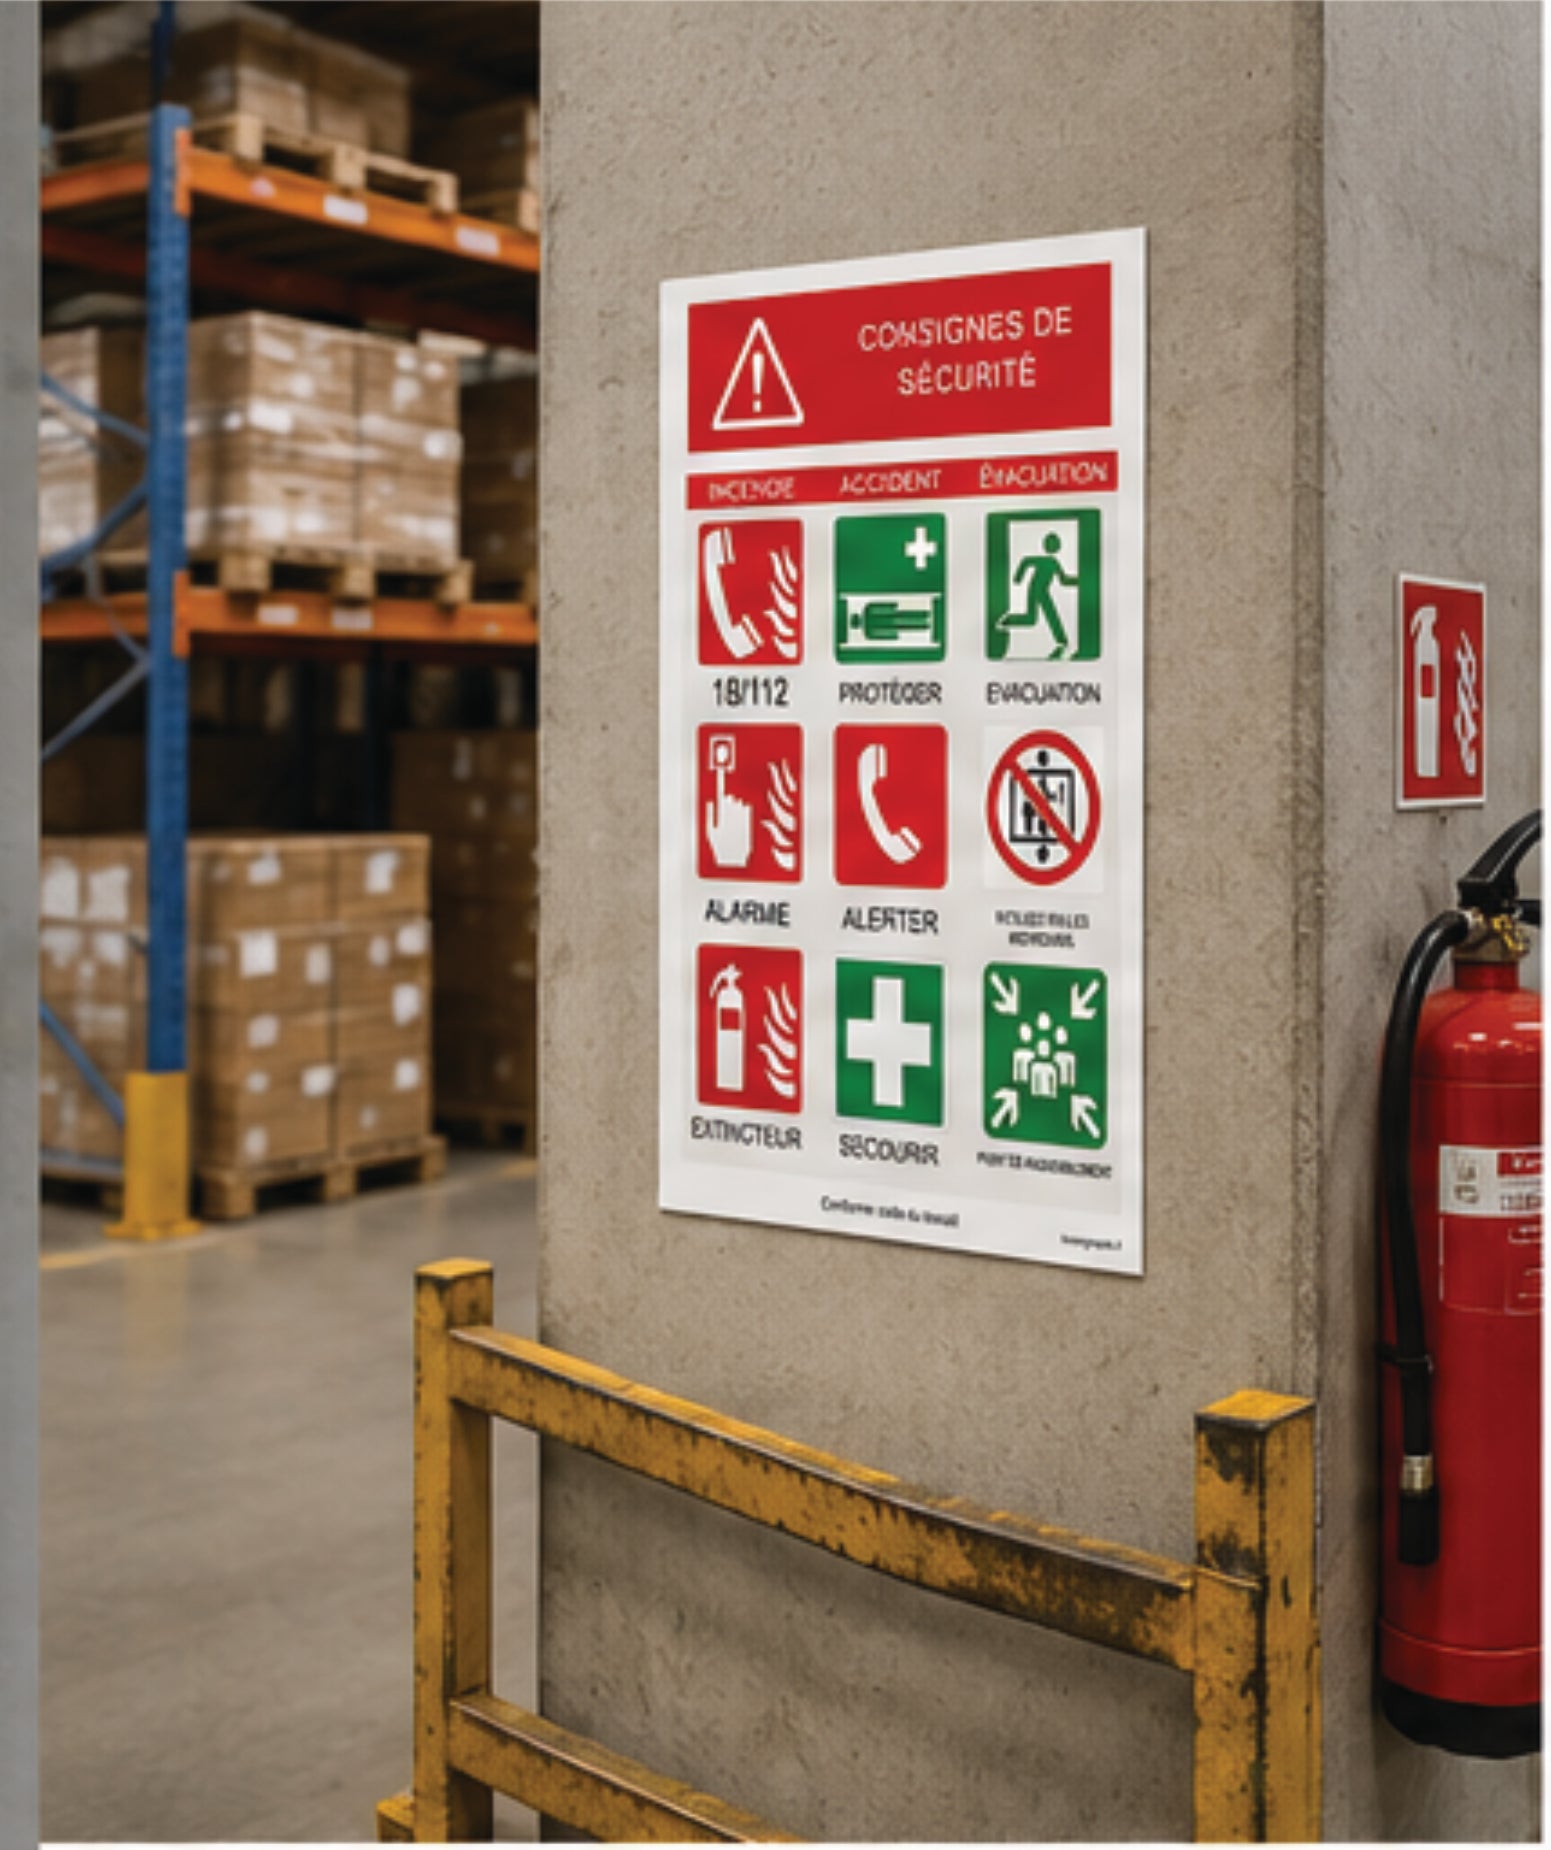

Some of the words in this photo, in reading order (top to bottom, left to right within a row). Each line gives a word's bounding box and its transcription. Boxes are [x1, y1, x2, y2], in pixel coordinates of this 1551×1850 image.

[857, 310, 1024, 351] CONSIGNES
[1033, 306, 1073, 338] DE
[897, 351, 1037, 395] SÉCURITÉ
[839, 470, 942, 495] ACCIDENT
[713, 677, 790, 707] 18/112
[704, 900, 791, 927] ALARME
[841, 906, 939, 935] ALERTER
[690, 1116, 802, 1150] EXTINCTEUR
